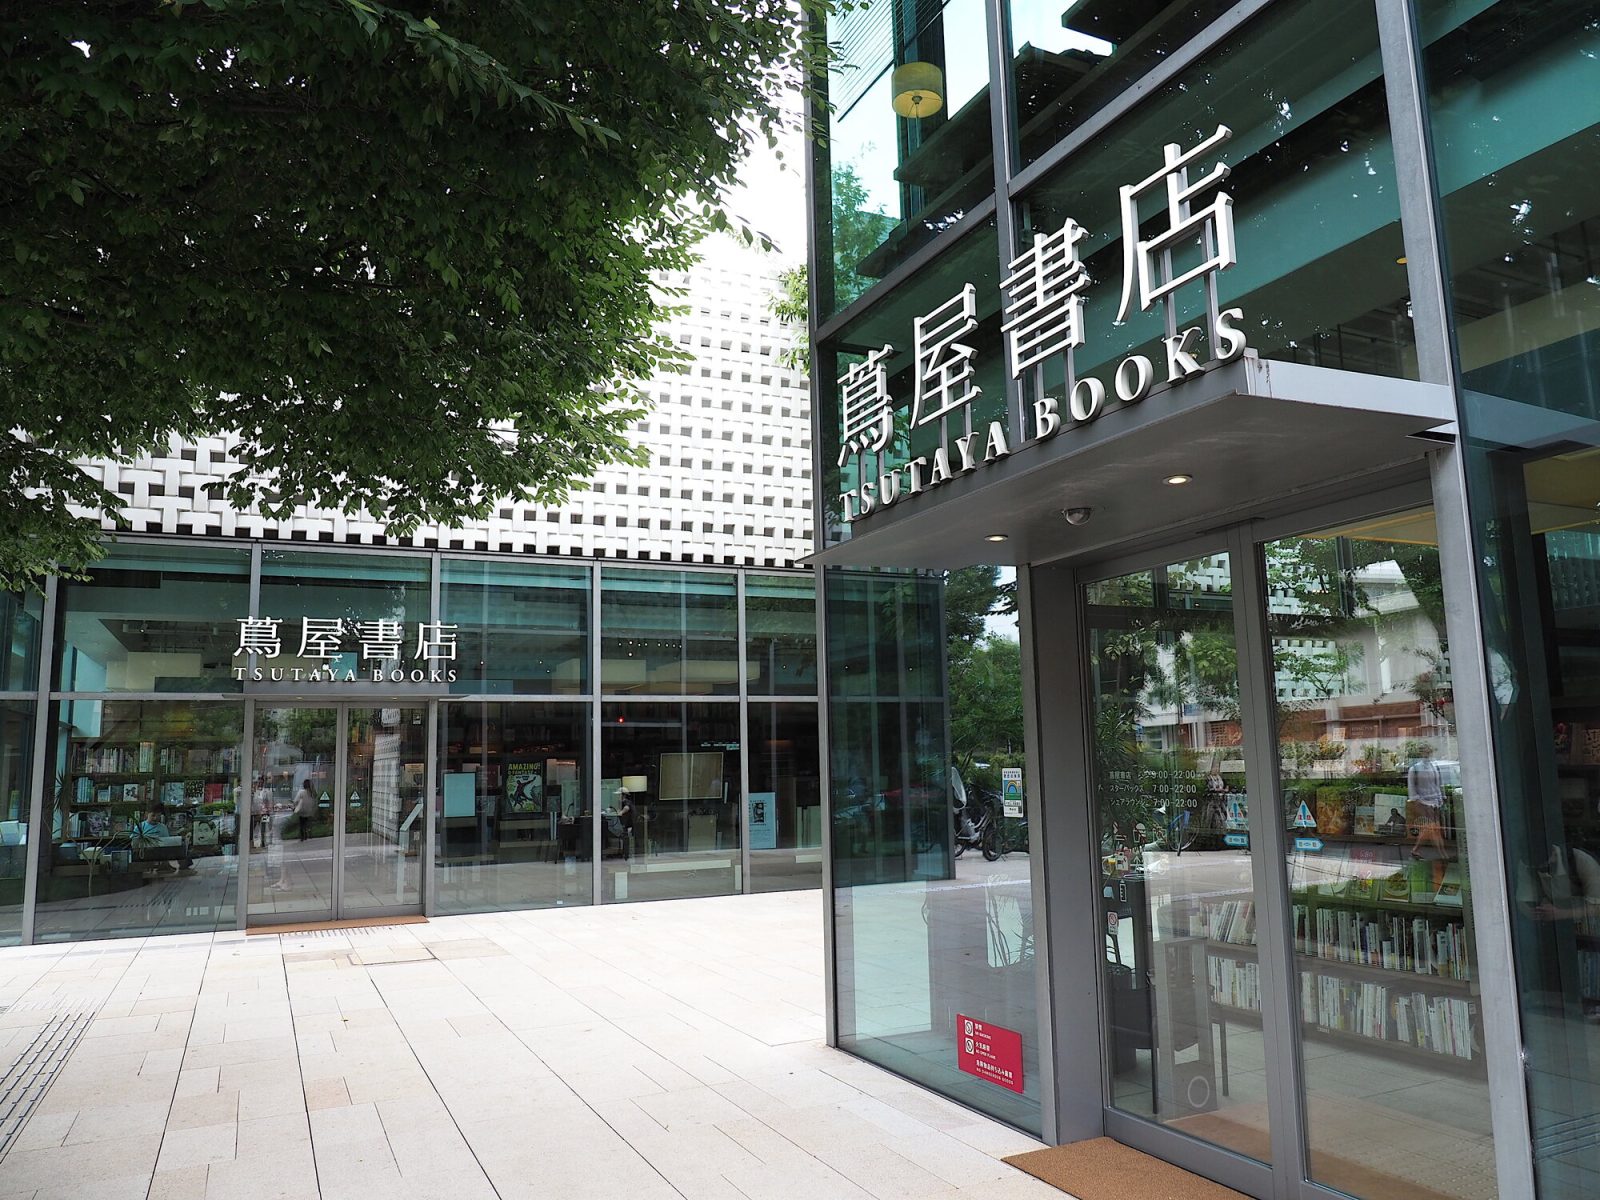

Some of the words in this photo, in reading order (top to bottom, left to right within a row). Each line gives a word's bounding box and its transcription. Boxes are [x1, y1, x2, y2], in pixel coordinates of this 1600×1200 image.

[836, 124, 1237, 469] 蔦屋書店
[838, 420, 1011, 523] TSUTAYA
[1033, 307, 1246, 441] BOOKS
[233, 615, 458, 661] 蔦屋書店
[234, 667, 357, 682] TSUTAYA
[373, 668, 458, 683] BOOKS
